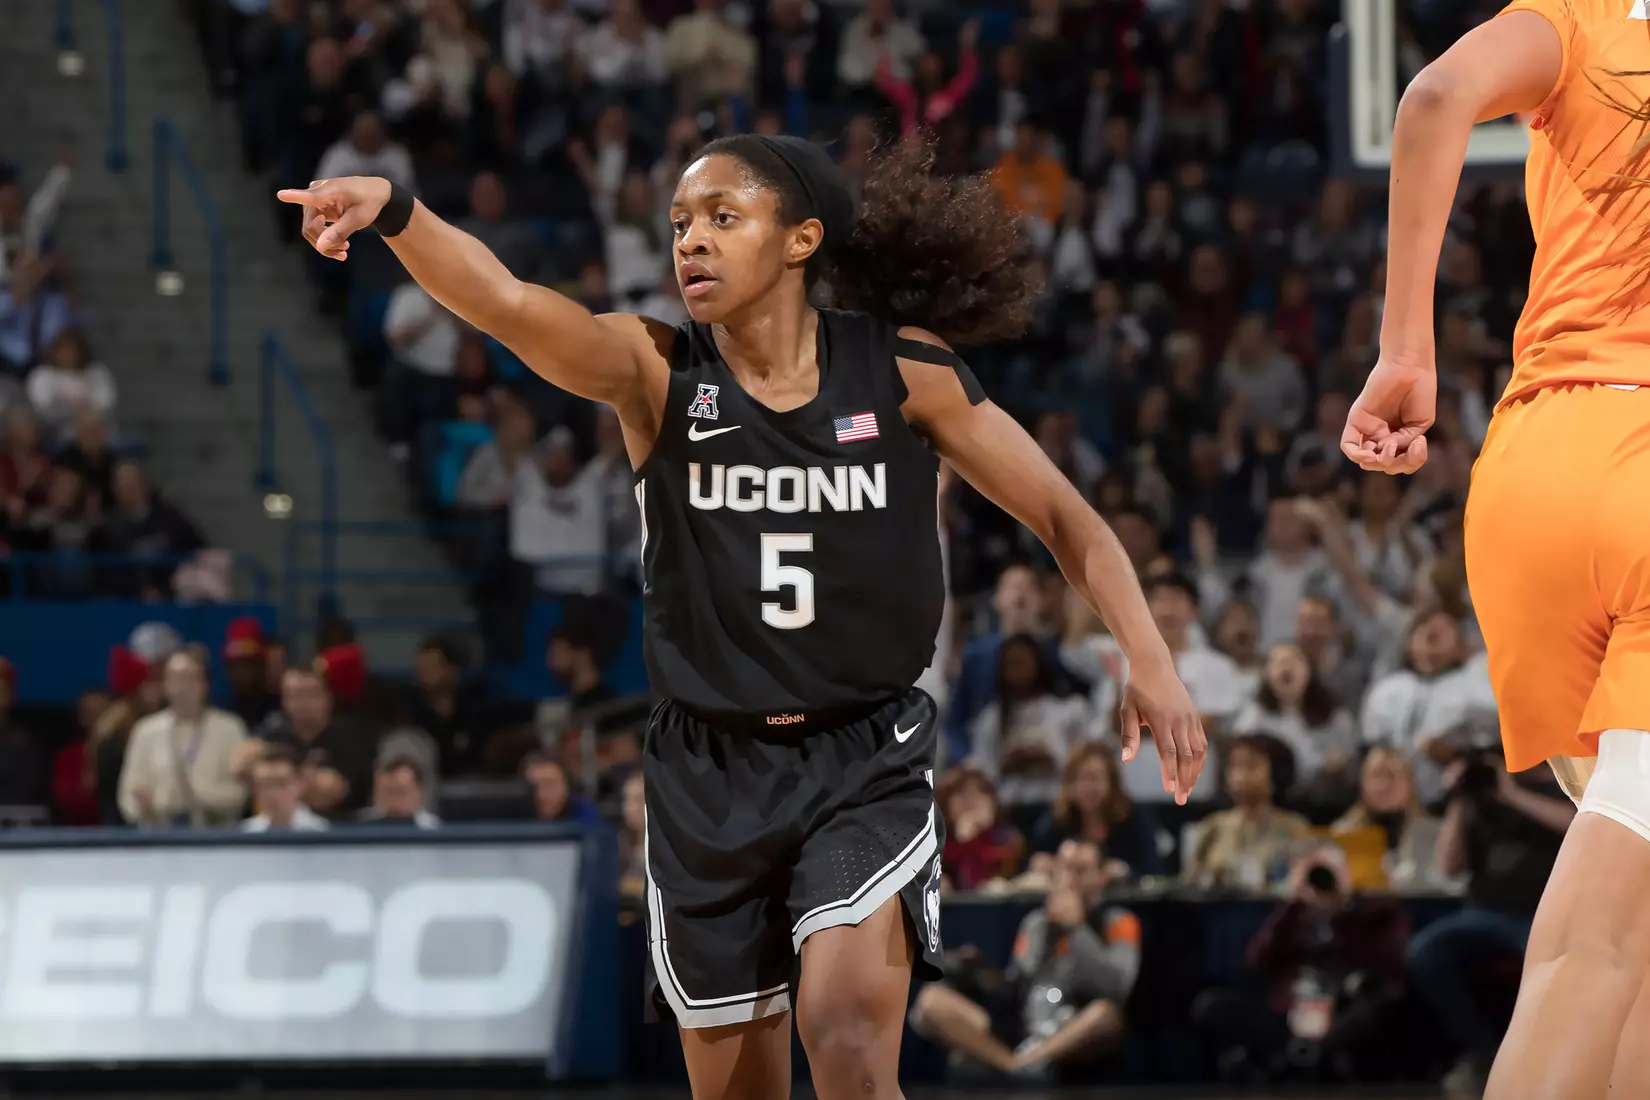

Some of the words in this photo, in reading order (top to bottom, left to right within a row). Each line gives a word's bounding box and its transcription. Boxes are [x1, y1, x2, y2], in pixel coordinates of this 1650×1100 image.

[688, 462, 887, 513] UCONN
[760, 532, 815, 630] 5
[766, 713, 805, 726] UCONN
[0, 878, 557, 1020] EICO
